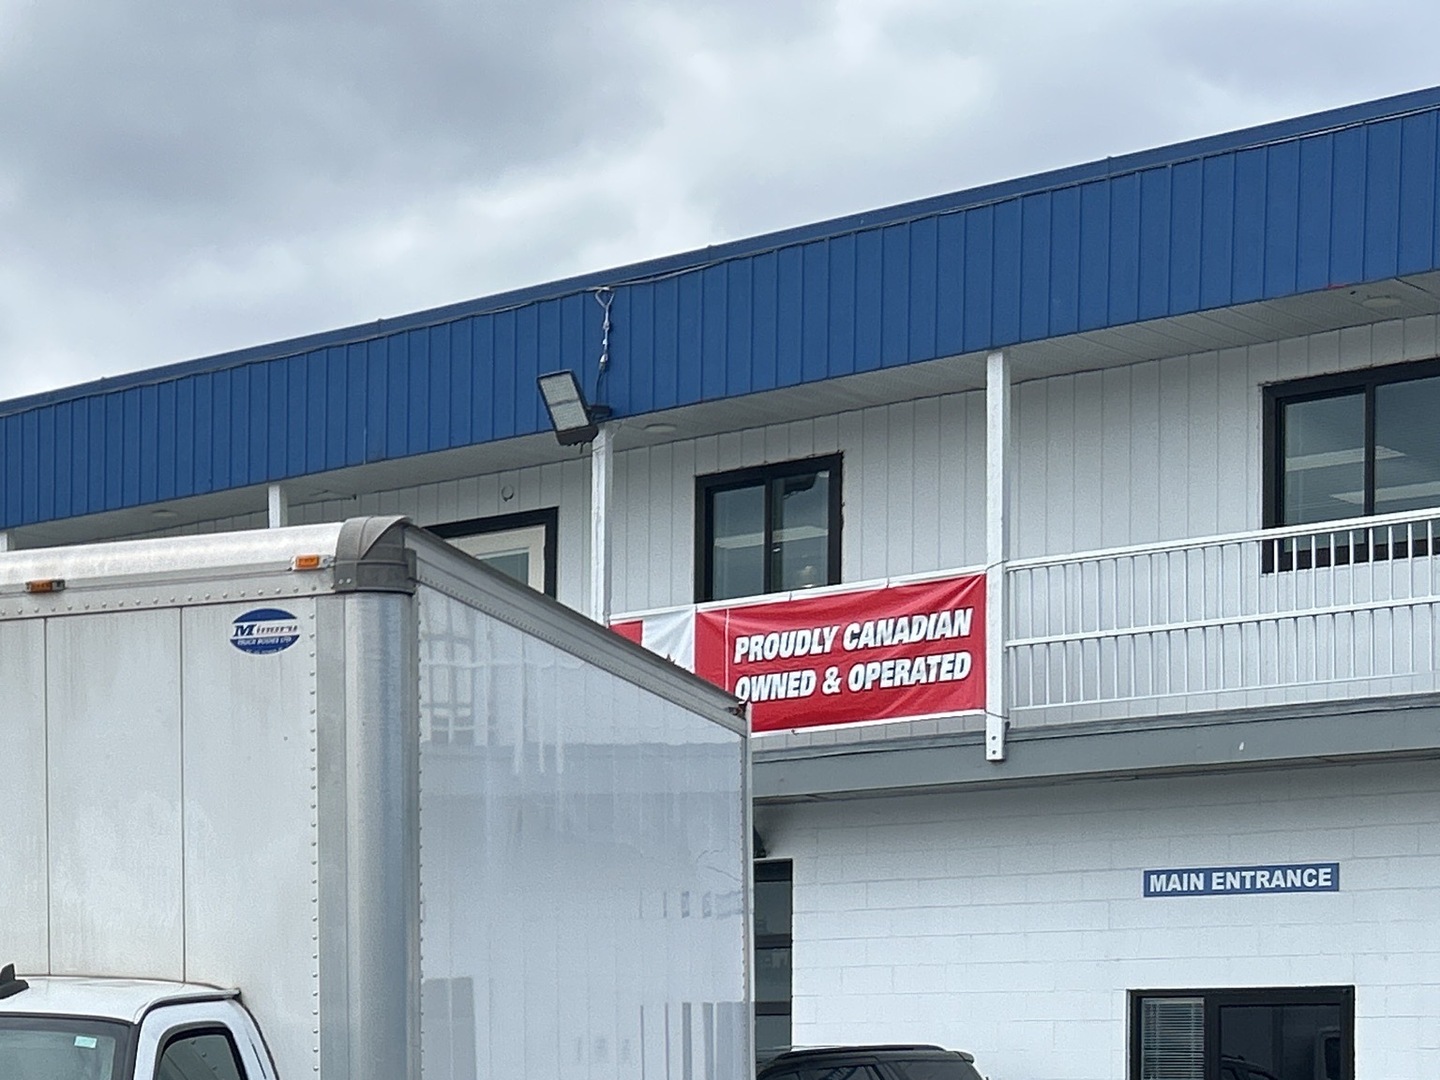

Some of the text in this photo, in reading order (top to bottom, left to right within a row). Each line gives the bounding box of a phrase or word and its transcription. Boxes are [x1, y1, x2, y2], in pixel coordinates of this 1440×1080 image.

[733, 608, 974, 664] PROUDLY CANADIAN
[734, 651, 972, 705] OWNED & OPERATED
[1149, 868, 1332, 892] MAIN ENTRANCE
